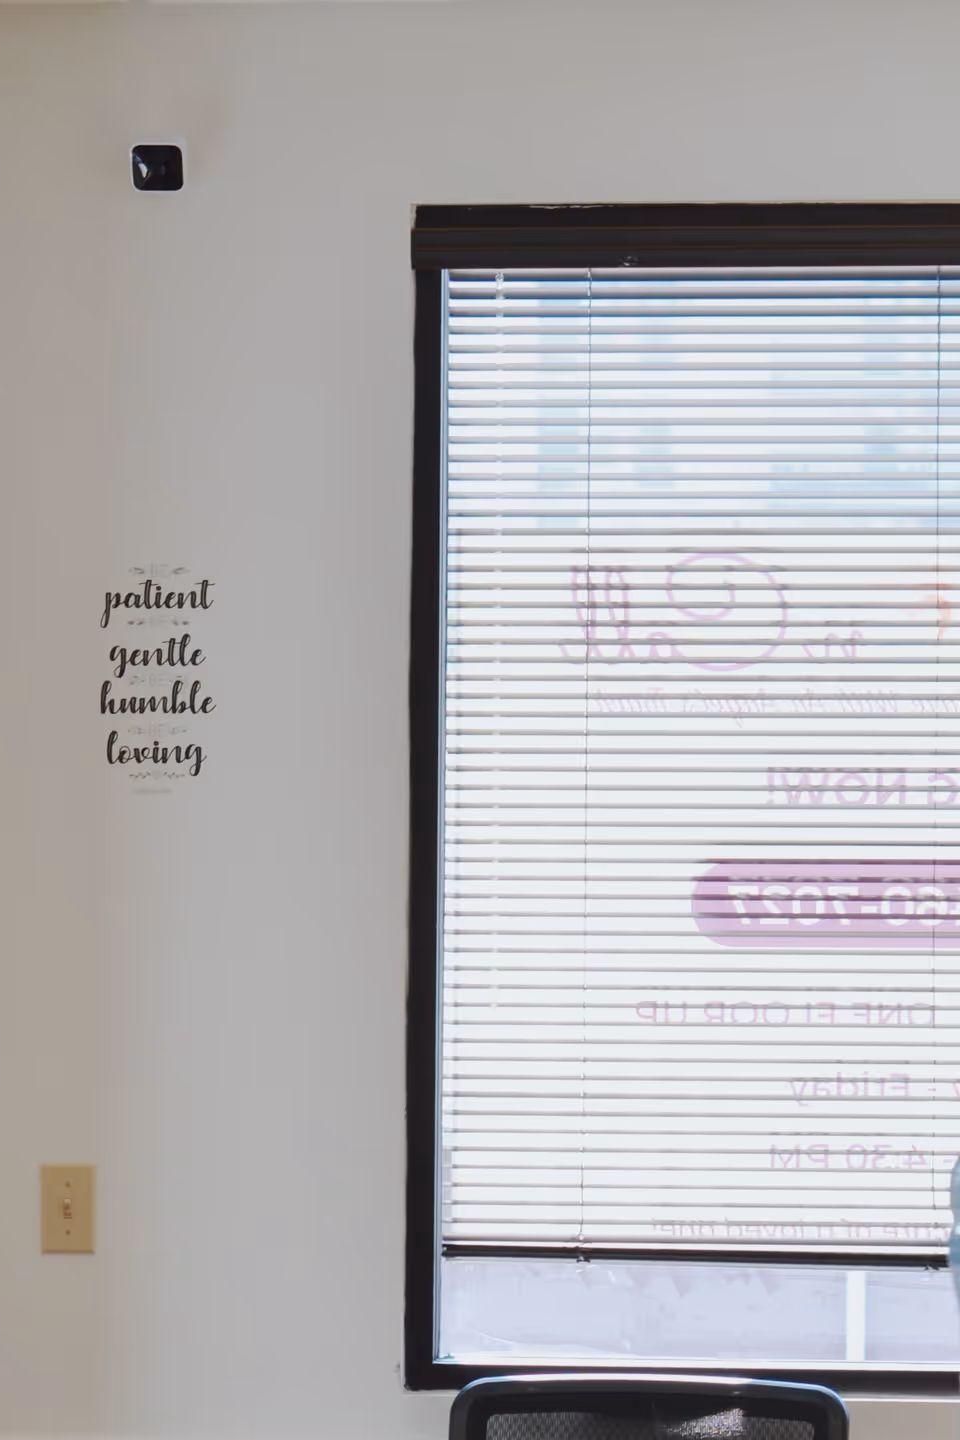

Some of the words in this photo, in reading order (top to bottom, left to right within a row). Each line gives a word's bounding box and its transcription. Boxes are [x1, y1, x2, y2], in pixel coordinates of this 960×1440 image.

[100, 579, 215, 628] patient
[109, 633, 206, 678] gentle
[100, 680, 216, 714] humble
[107, 730, 207, 776] loving
